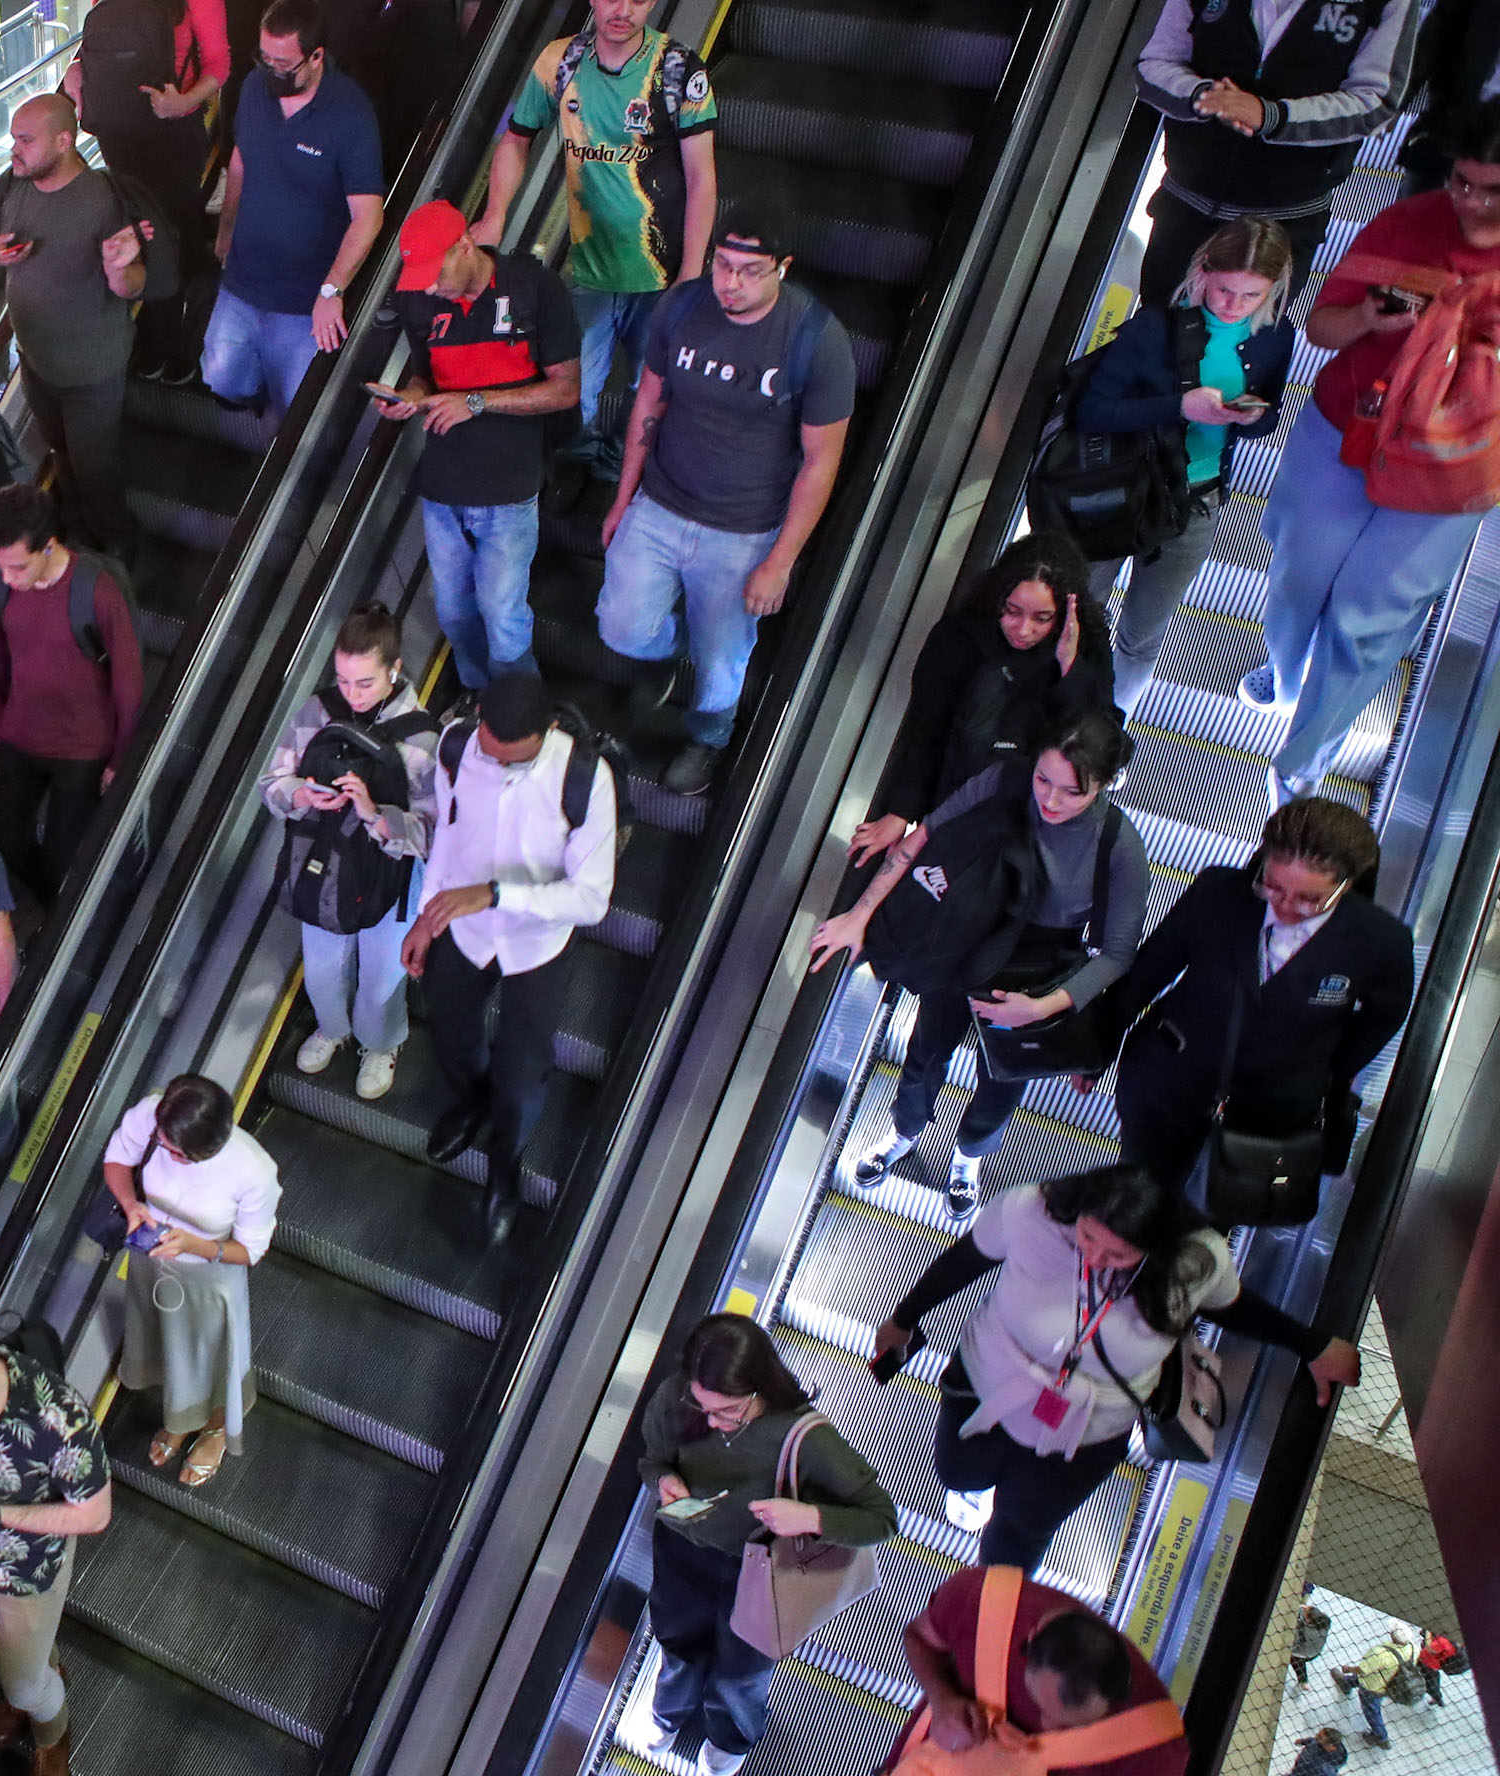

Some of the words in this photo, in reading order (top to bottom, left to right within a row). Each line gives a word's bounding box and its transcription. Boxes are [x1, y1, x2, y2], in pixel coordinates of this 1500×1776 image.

[1313, 3, 1358, 43] NS
[1172, 1516, 1192, 1550] Deixe
[1169, 1552, 1178, 1560] a
[1150, 1563, 1176, 1617] esquerda
[1139, 1613, 1159, 1646] livre.
